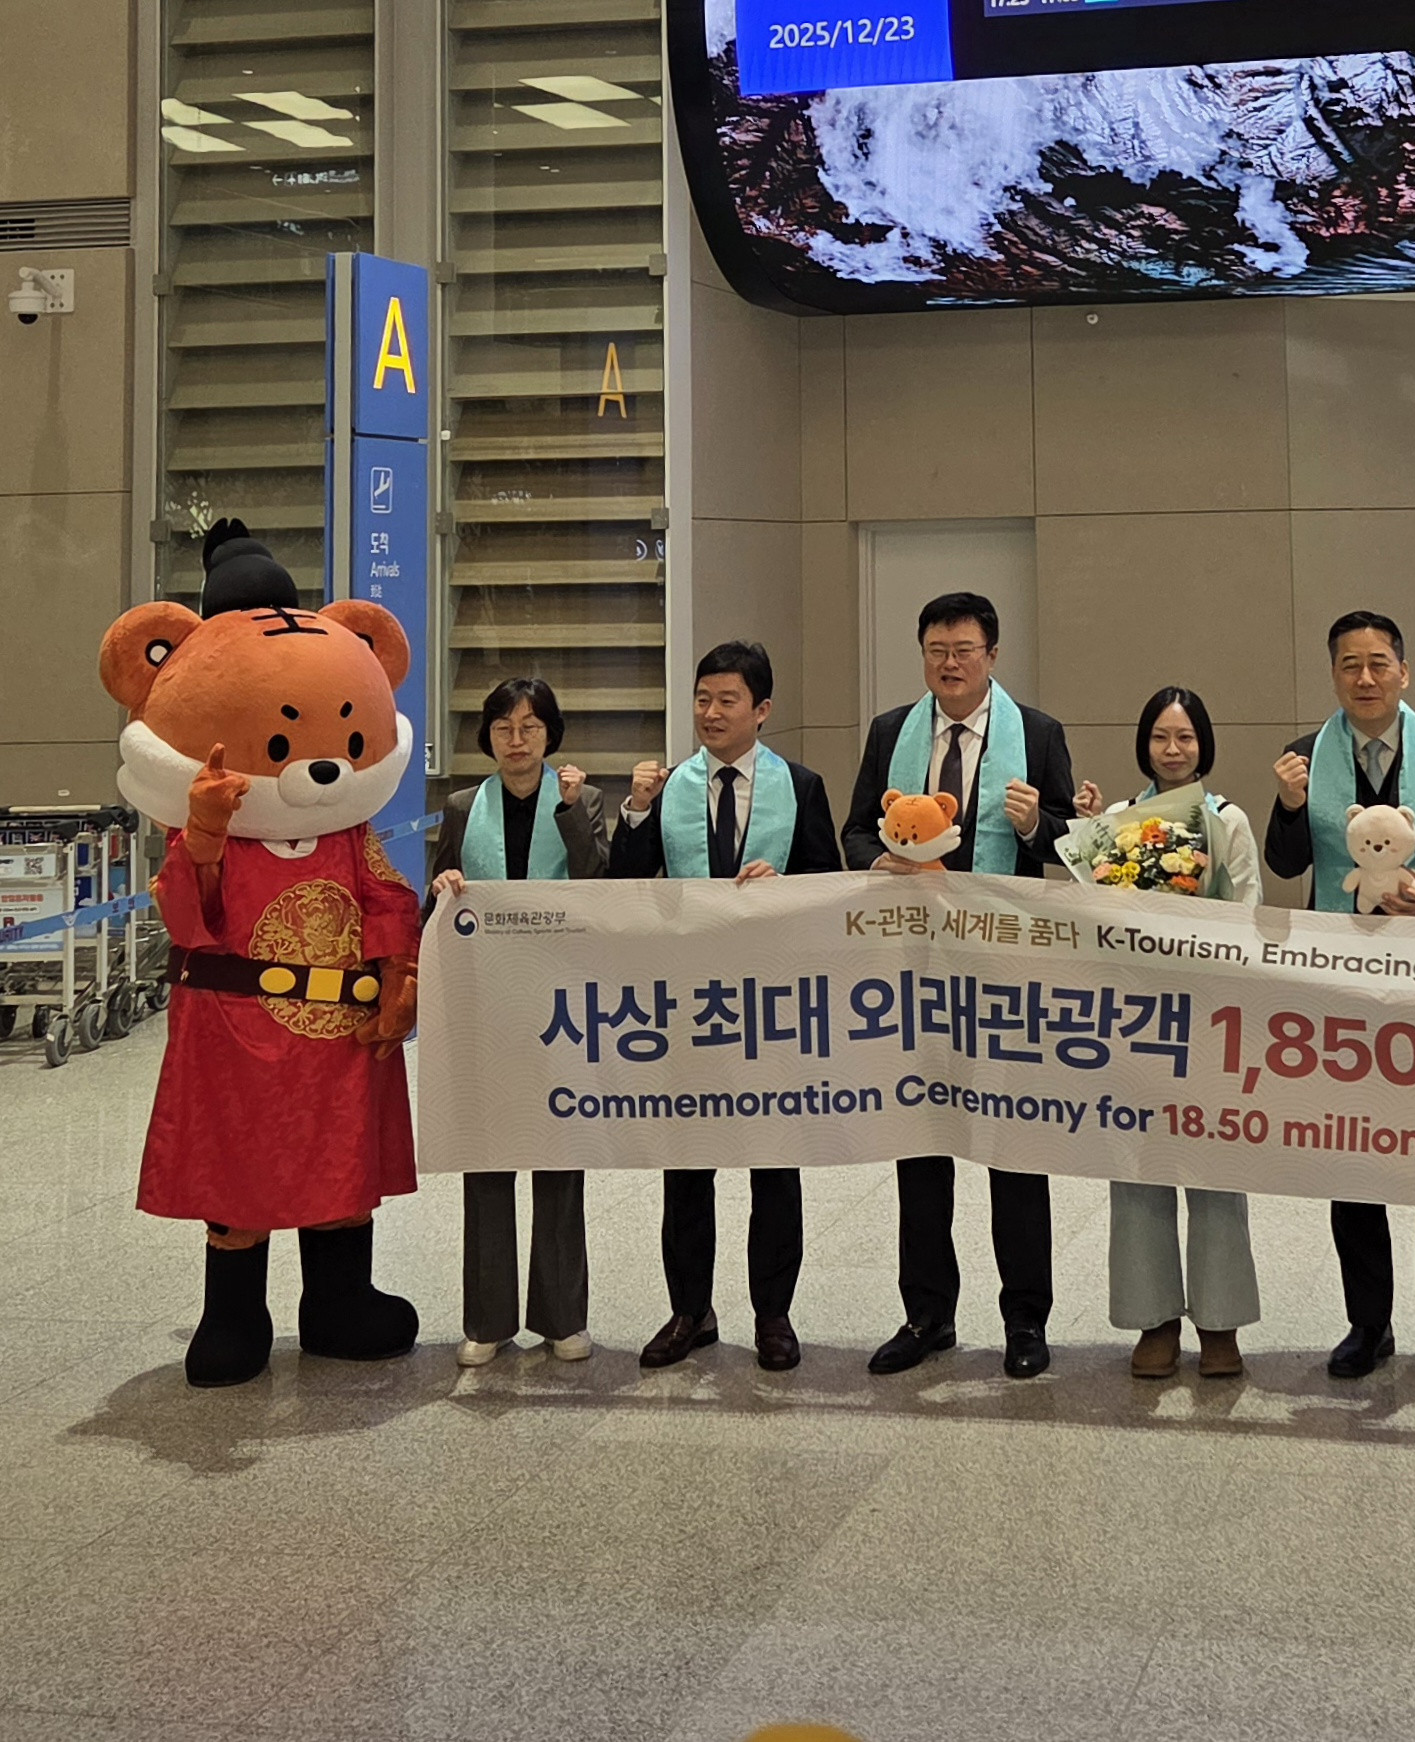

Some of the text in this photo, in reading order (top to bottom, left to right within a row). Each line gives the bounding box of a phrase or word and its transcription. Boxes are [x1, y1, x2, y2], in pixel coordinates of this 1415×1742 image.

[769, 15, 915, 49] 2025/12/23
[373, 297, 416, 395] A
[370, 532, 389, 555] 도착
[370, 560, 400, 578] Arrivals
[846, 906, 1080, 949] K-관광, 세계를 품다
[1097, 925, 1249, 966] K-Tourism,
[539, 980, 677, 1062] 사상
[692, 975, 830, 1060] 최대
[848, 970, 1191, 1077] 외래관광객
[548, 1081, 883, 1119] Commemoration
[896, 1074, 1087, 1134] Ceremony
[1097, 1094, 1155, 1133] for
[1163, 1104, 1269, 1145] 18.50
